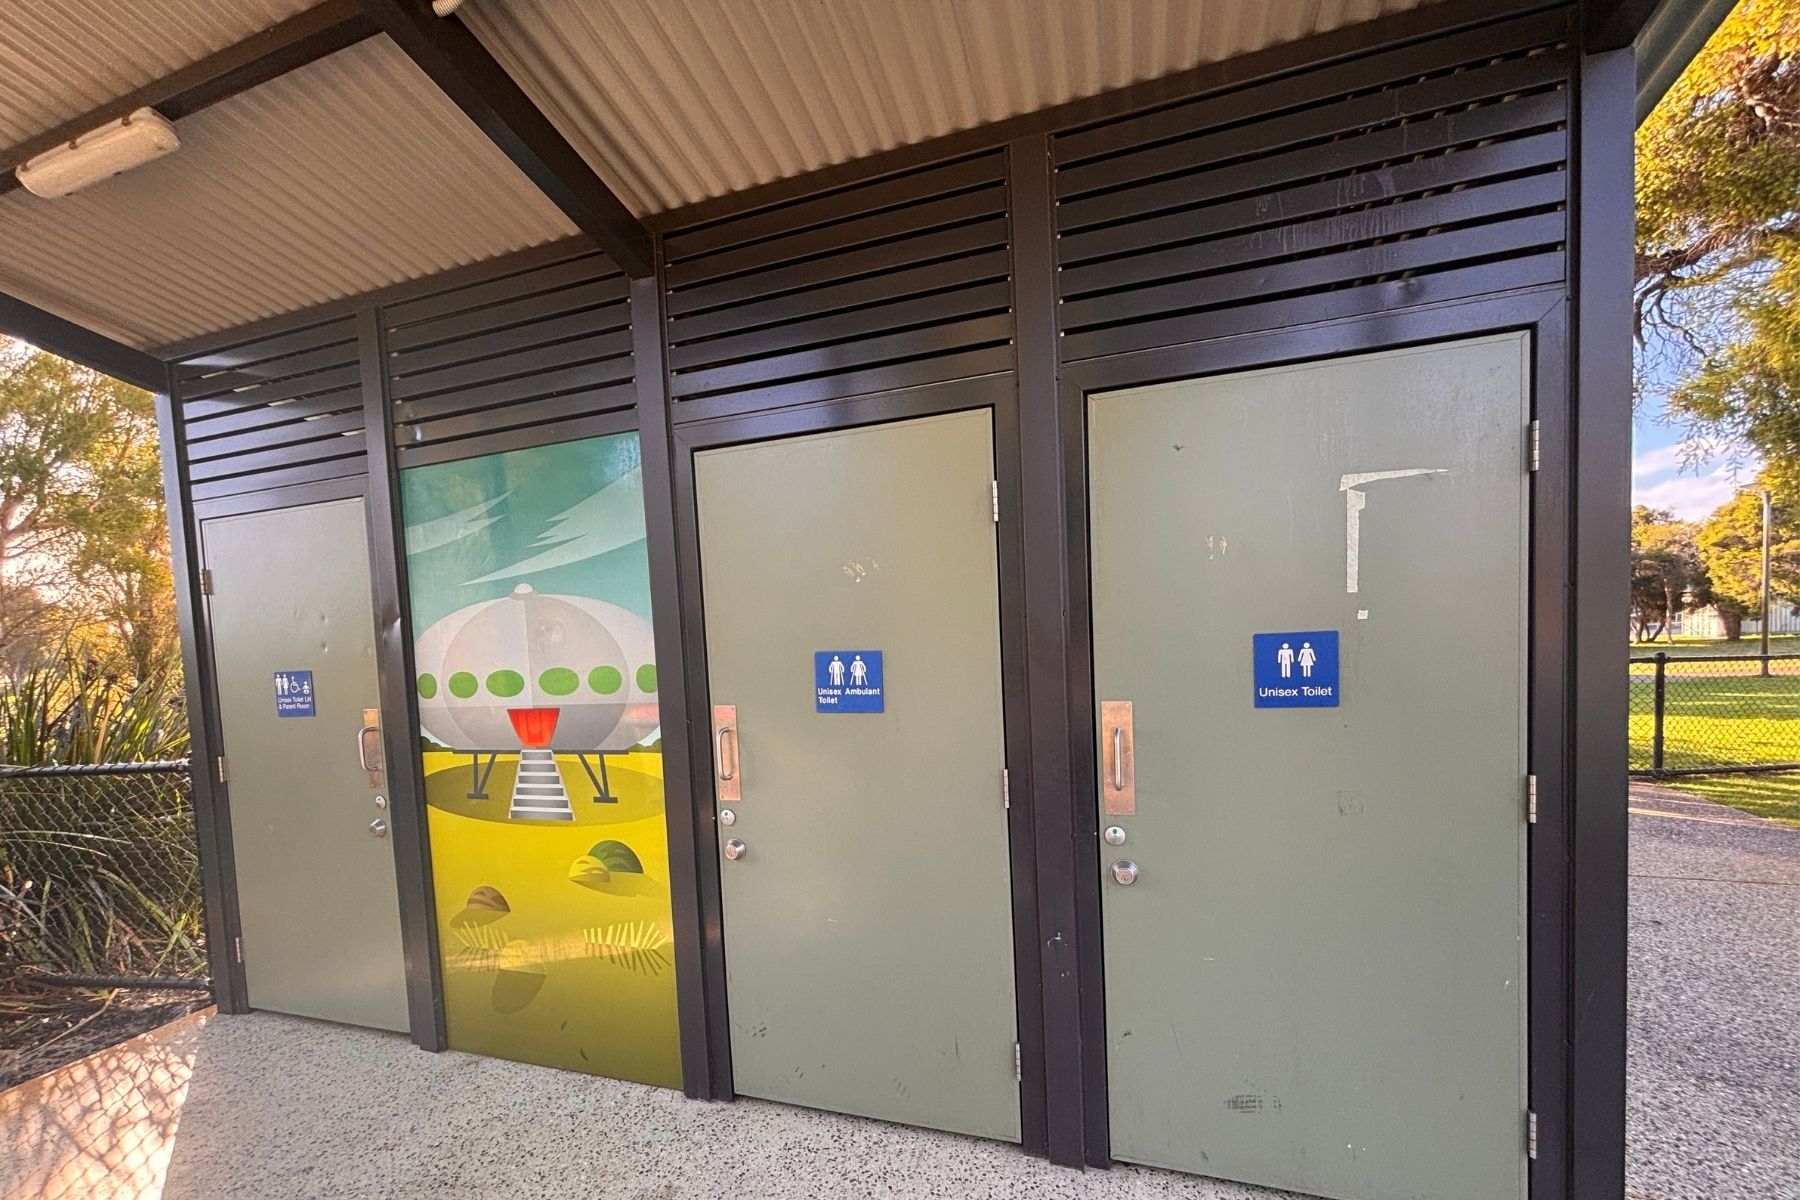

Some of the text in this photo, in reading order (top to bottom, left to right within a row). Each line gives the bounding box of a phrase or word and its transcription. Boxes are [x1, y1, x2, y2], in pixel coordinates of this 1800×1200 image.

[1259, 686, 1332, 697] Unisex Toilet
[818, 696, 838, 704] Toilet
